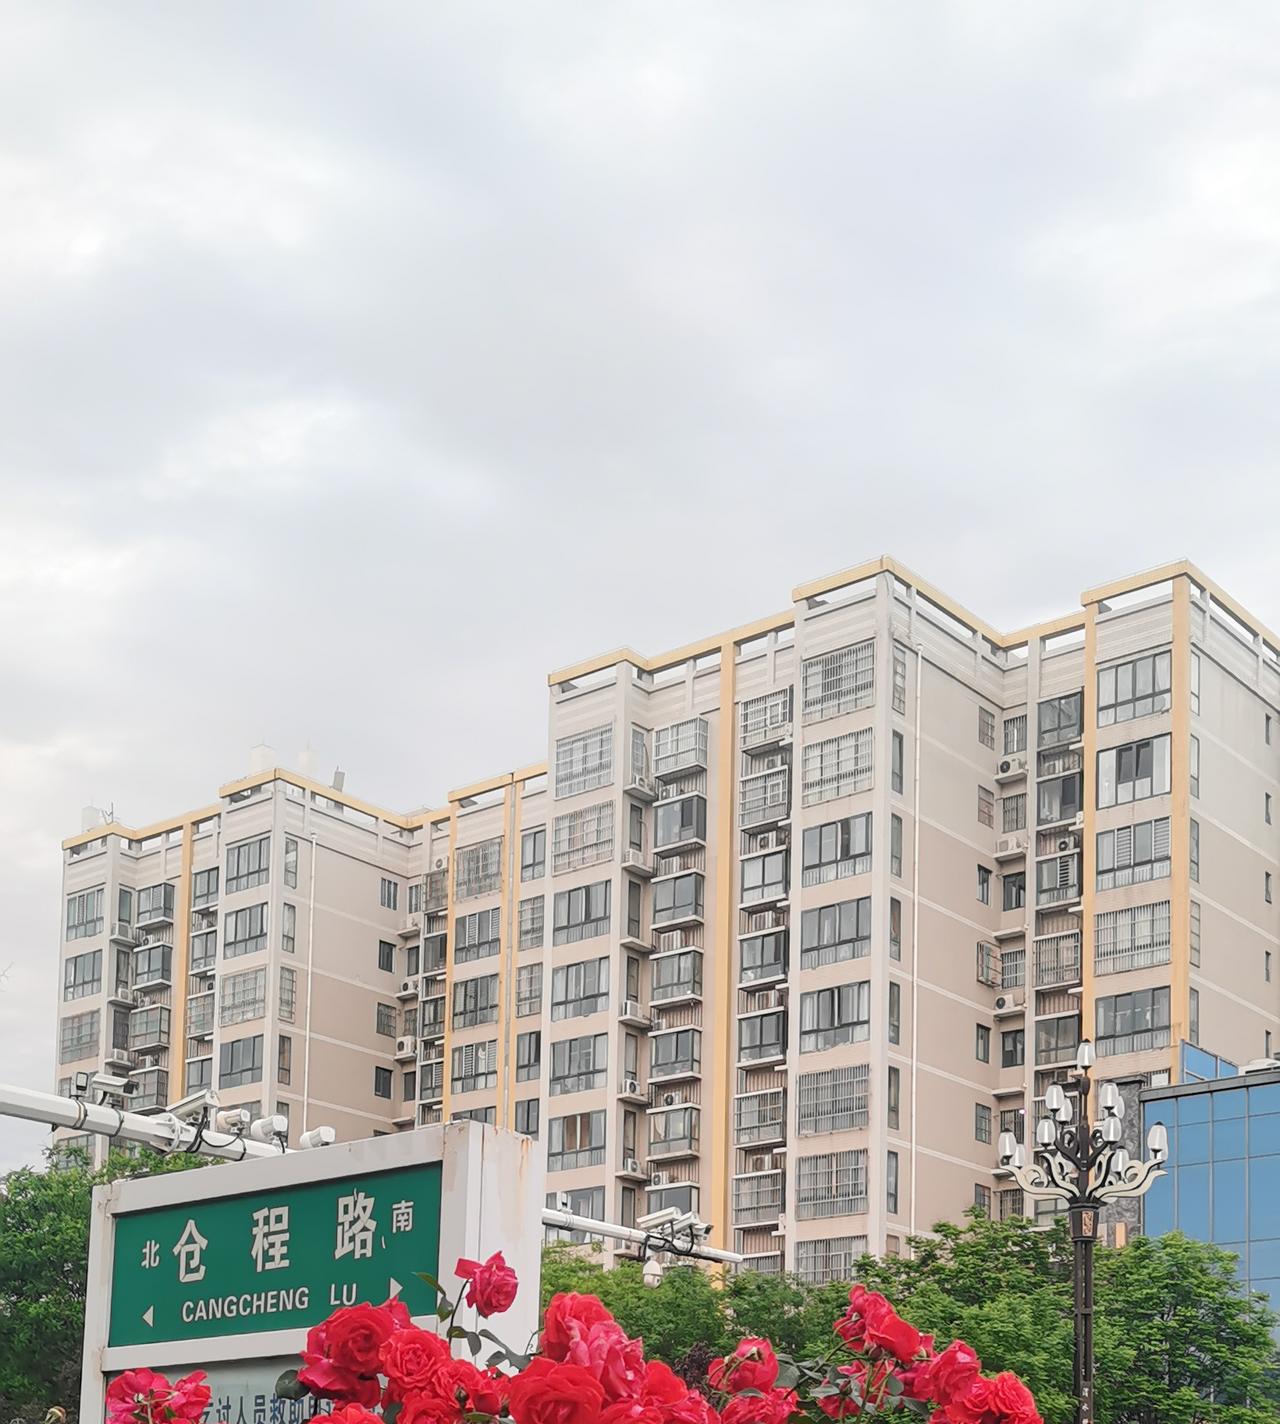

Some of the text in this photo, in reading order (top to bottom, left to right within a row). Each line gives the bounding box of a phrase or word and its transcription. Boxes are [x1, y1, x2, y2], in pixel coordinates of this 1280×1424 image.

[141, 1191, 414, 1283] 北 仓程路 南
[182, 1283, 357, 1323] CANGCHENG LU
